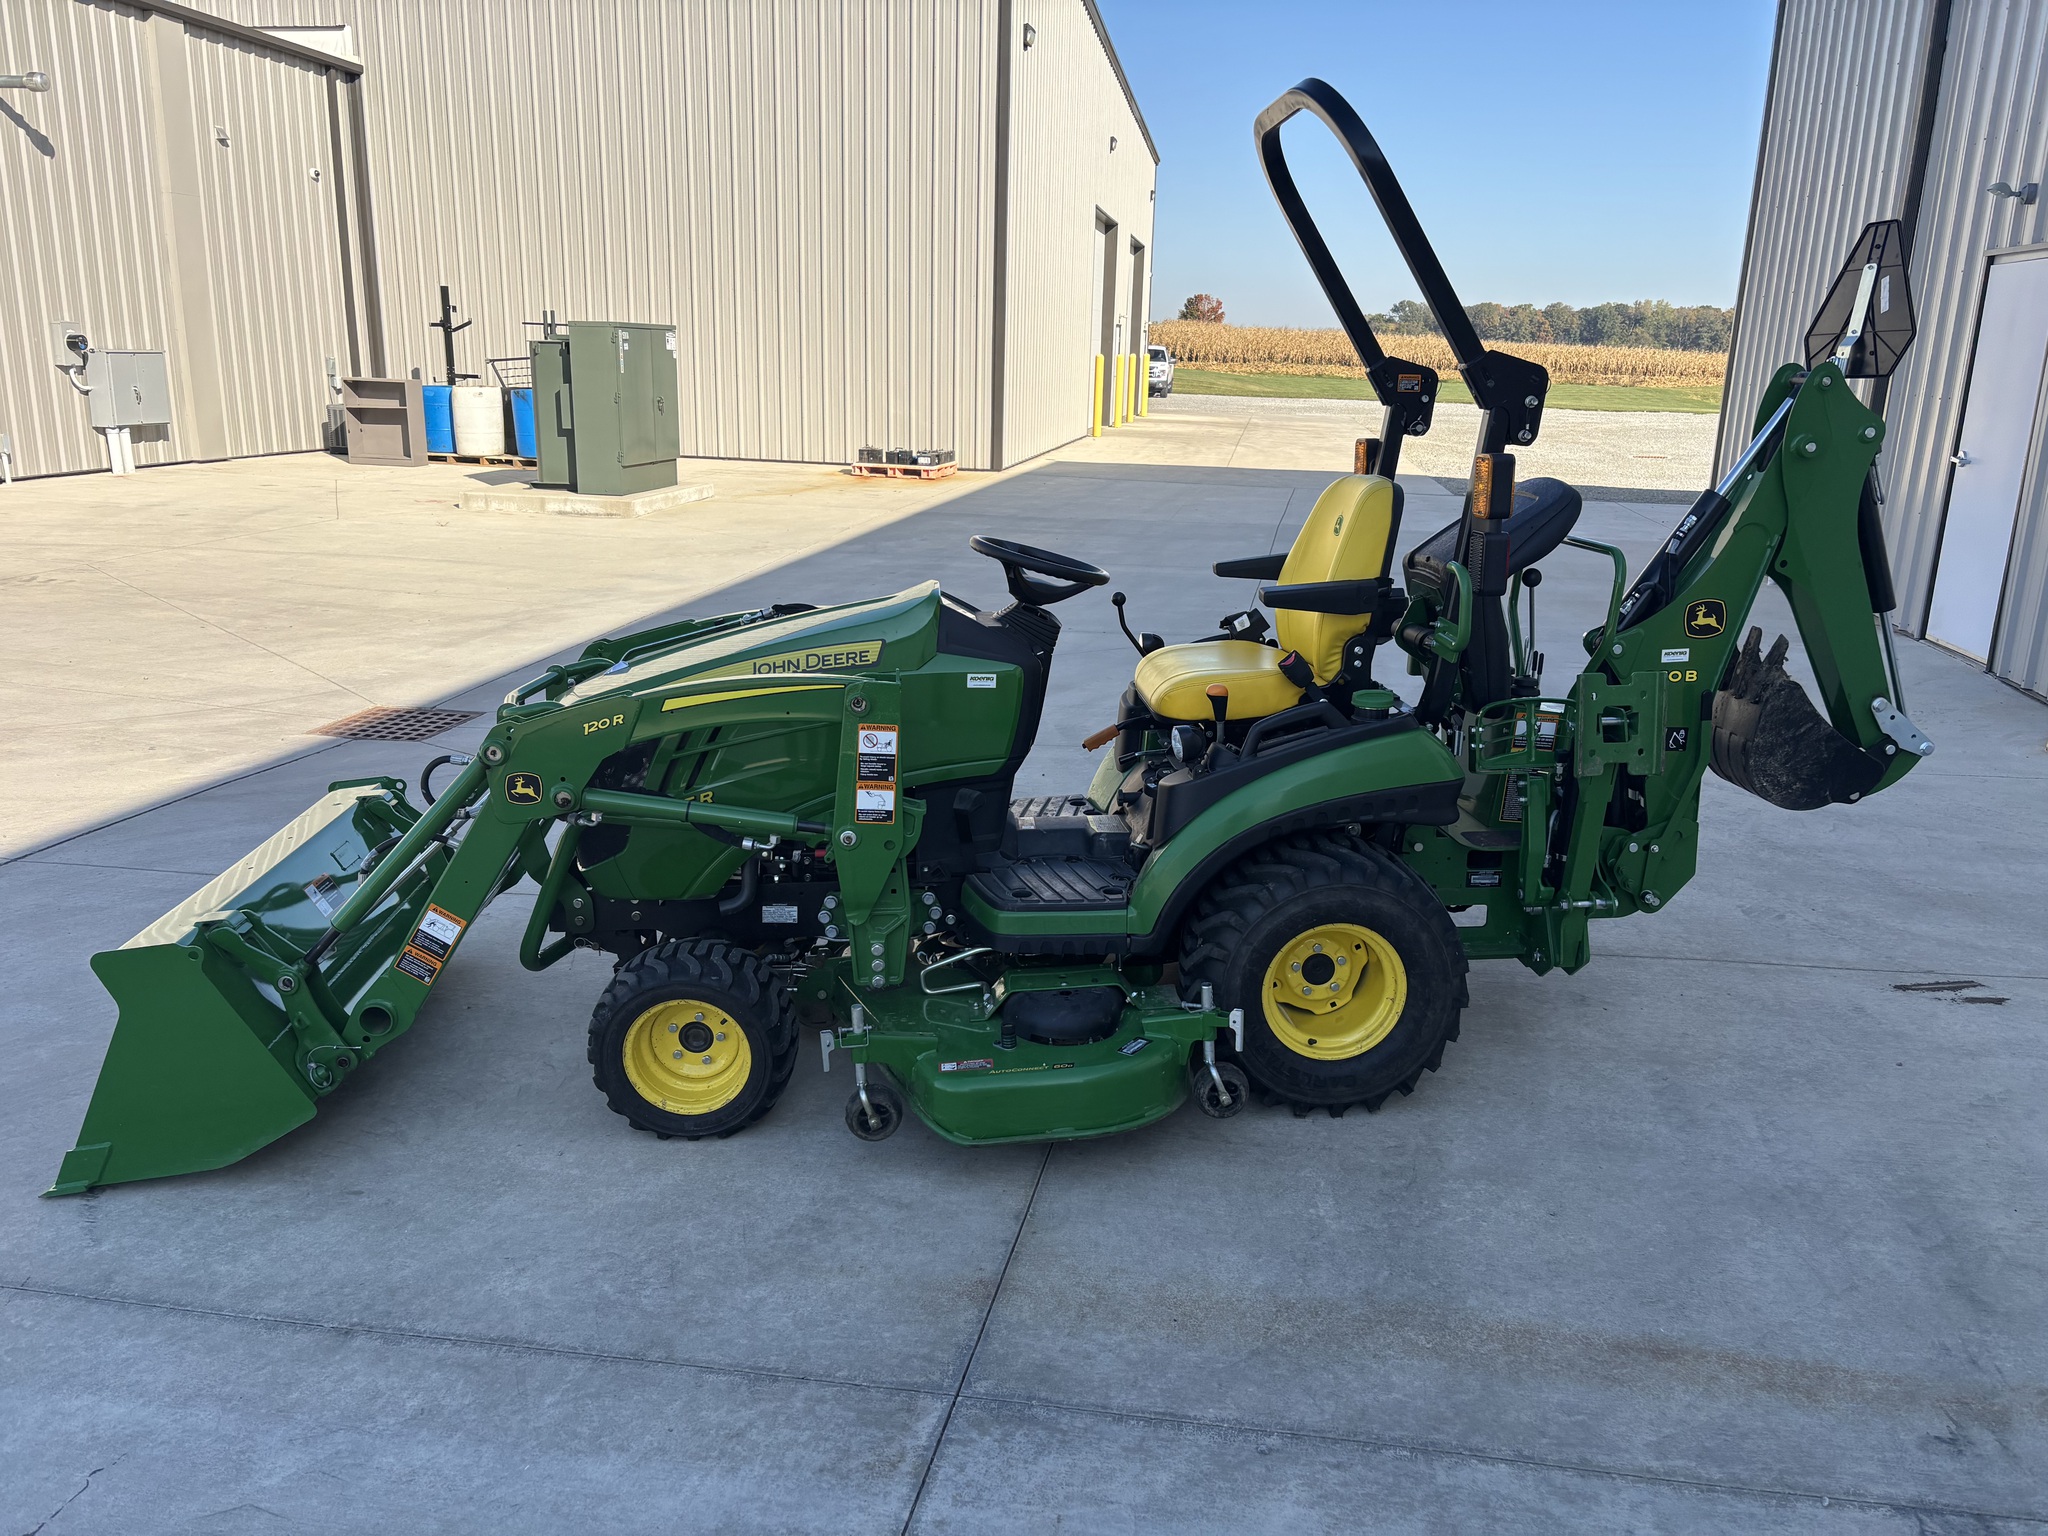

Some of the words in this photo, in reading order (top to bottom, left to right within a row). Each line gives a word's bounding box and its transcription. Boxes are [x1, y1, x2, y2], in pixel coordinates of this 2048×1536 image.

[753, 658, 800, 675] JOHN
[805, 650, 871, 669] DEERE
[1685, 670, 1698, 682] B
[582, 718, 610, 736] 120
[612, 714, 625, 726] R
[699, 791, 713, 804] R
[438, 908, 462, 925] WARNING
[414, 952, 438, 967] WARNING
